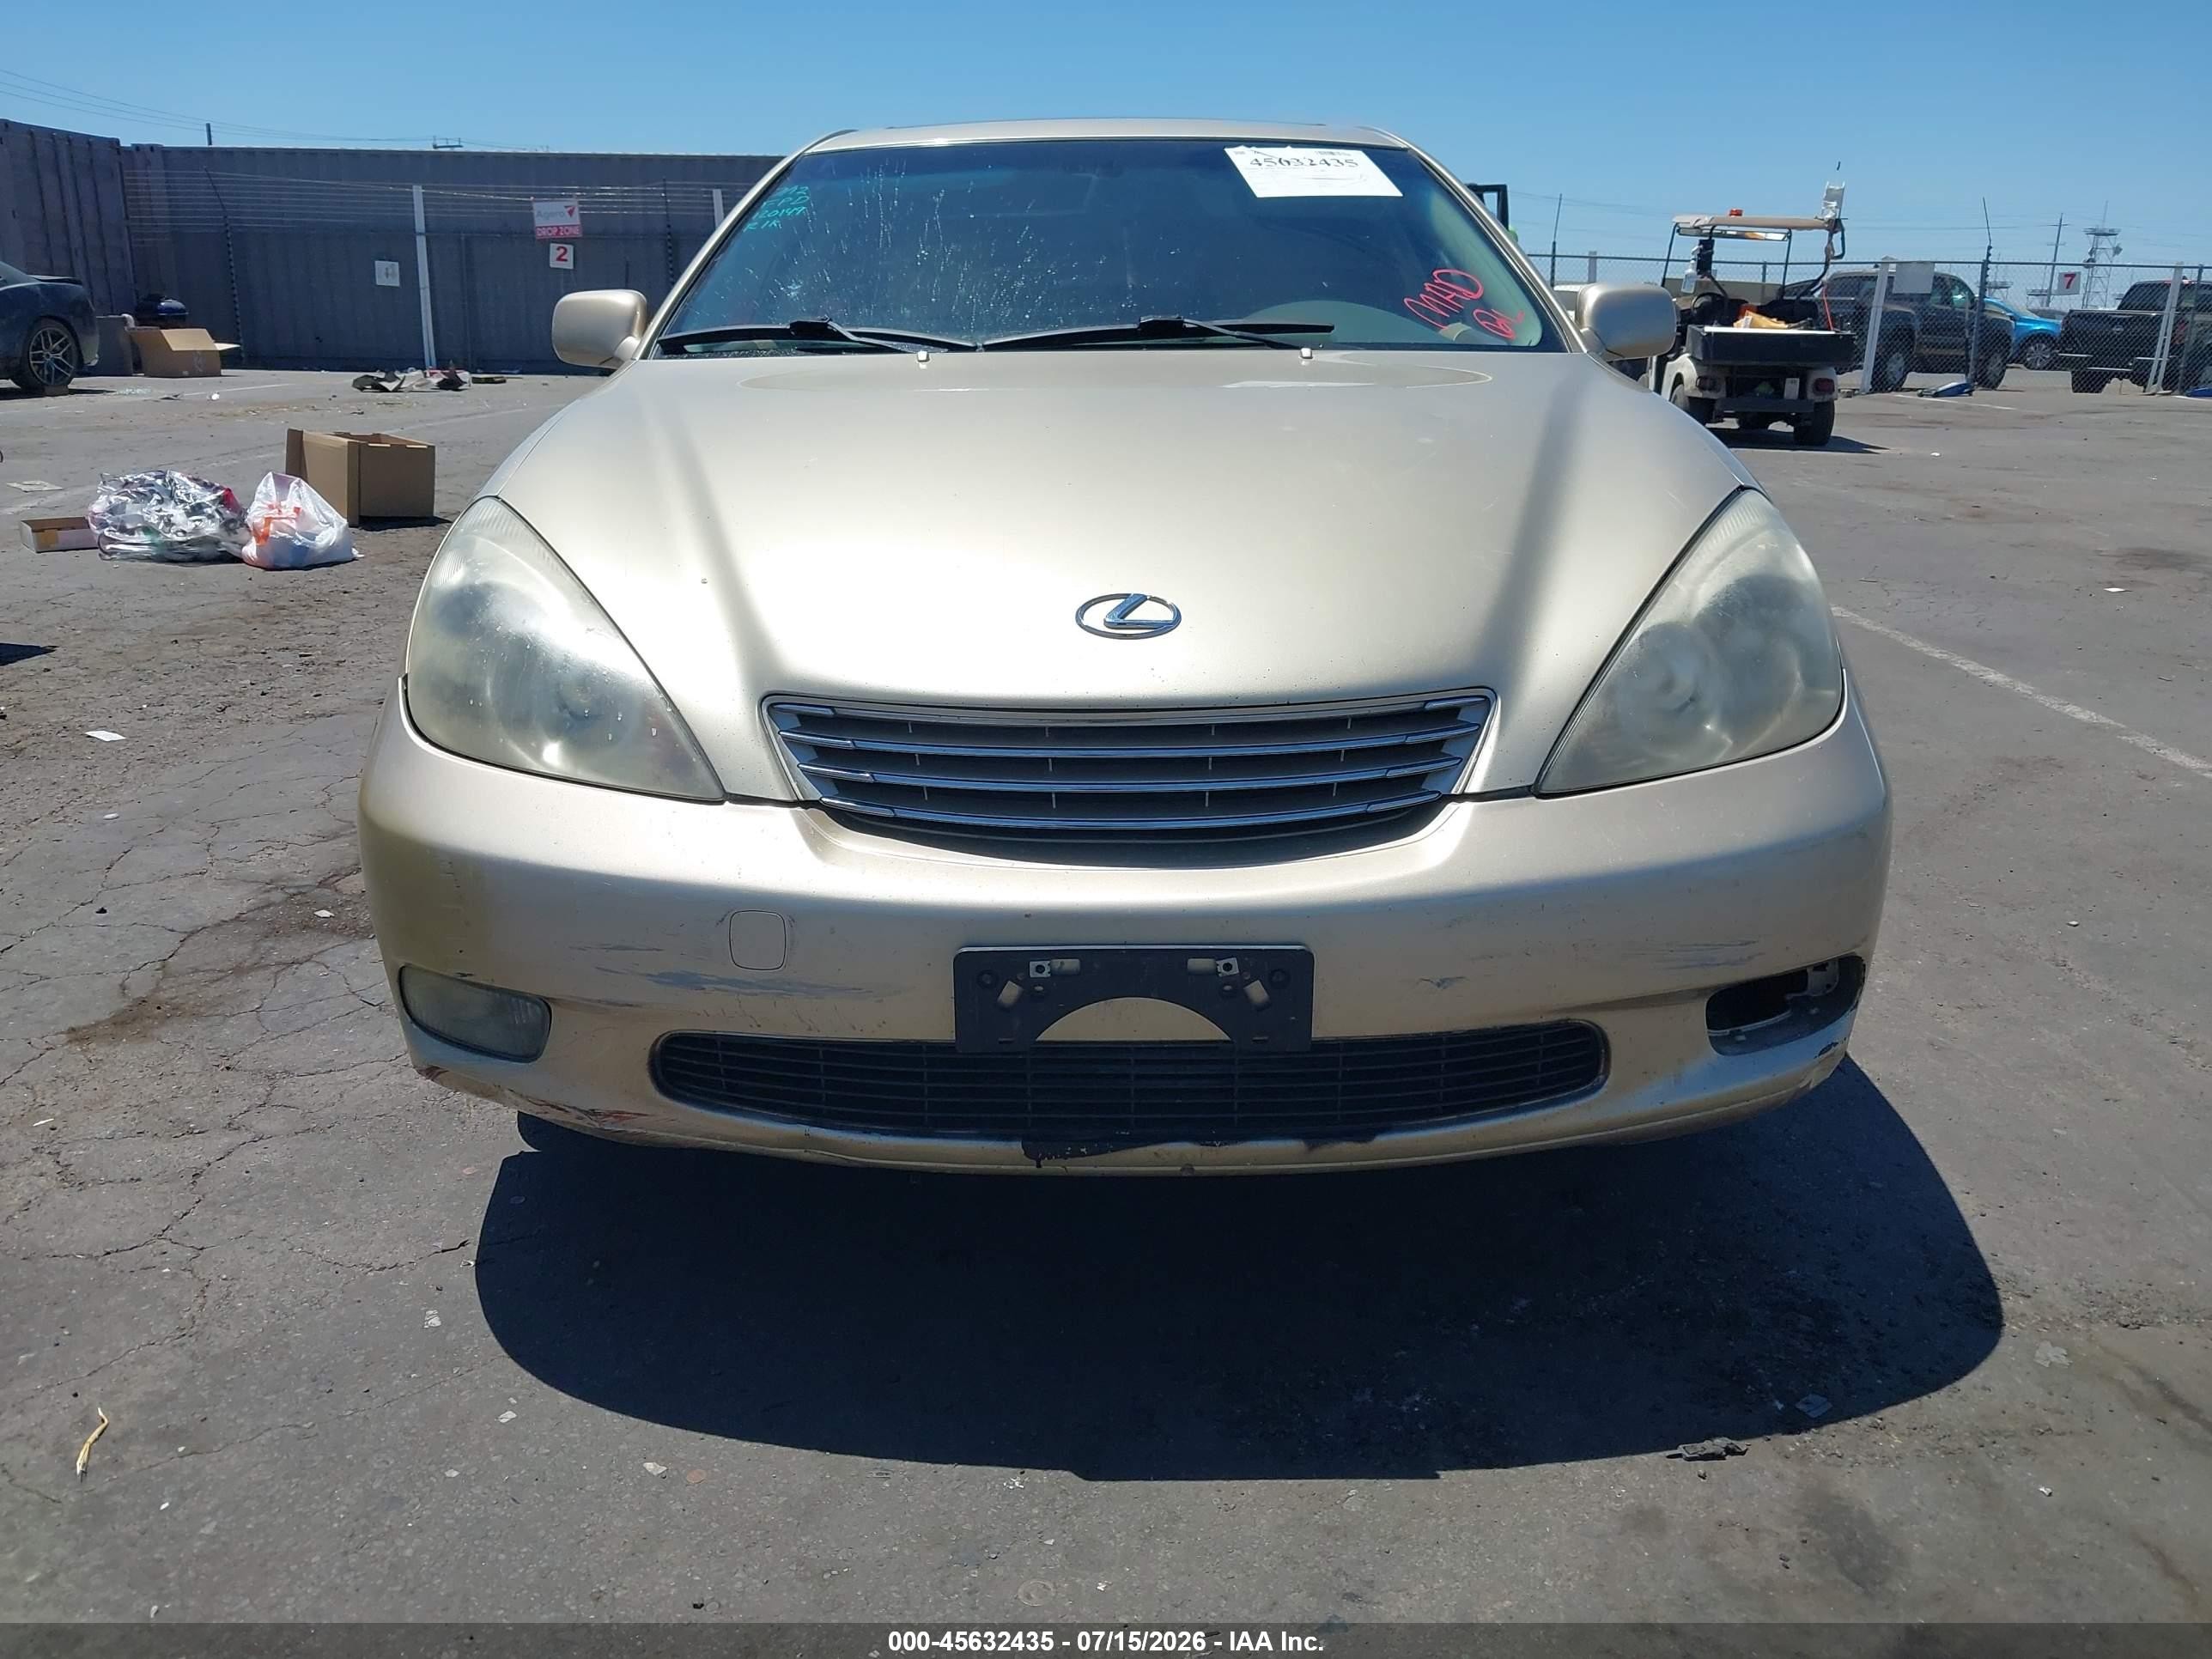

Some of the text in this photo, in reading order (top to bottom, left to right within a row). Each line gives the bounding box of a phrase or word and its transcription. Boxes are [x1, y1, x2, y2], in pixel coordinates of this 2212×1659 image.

[1250, 157, 1358, 167] 45632435
[536, 227, 558, 237] DROP
[556, 246, 568, 262] 2
[2064, 273, 2076, 289] 7
